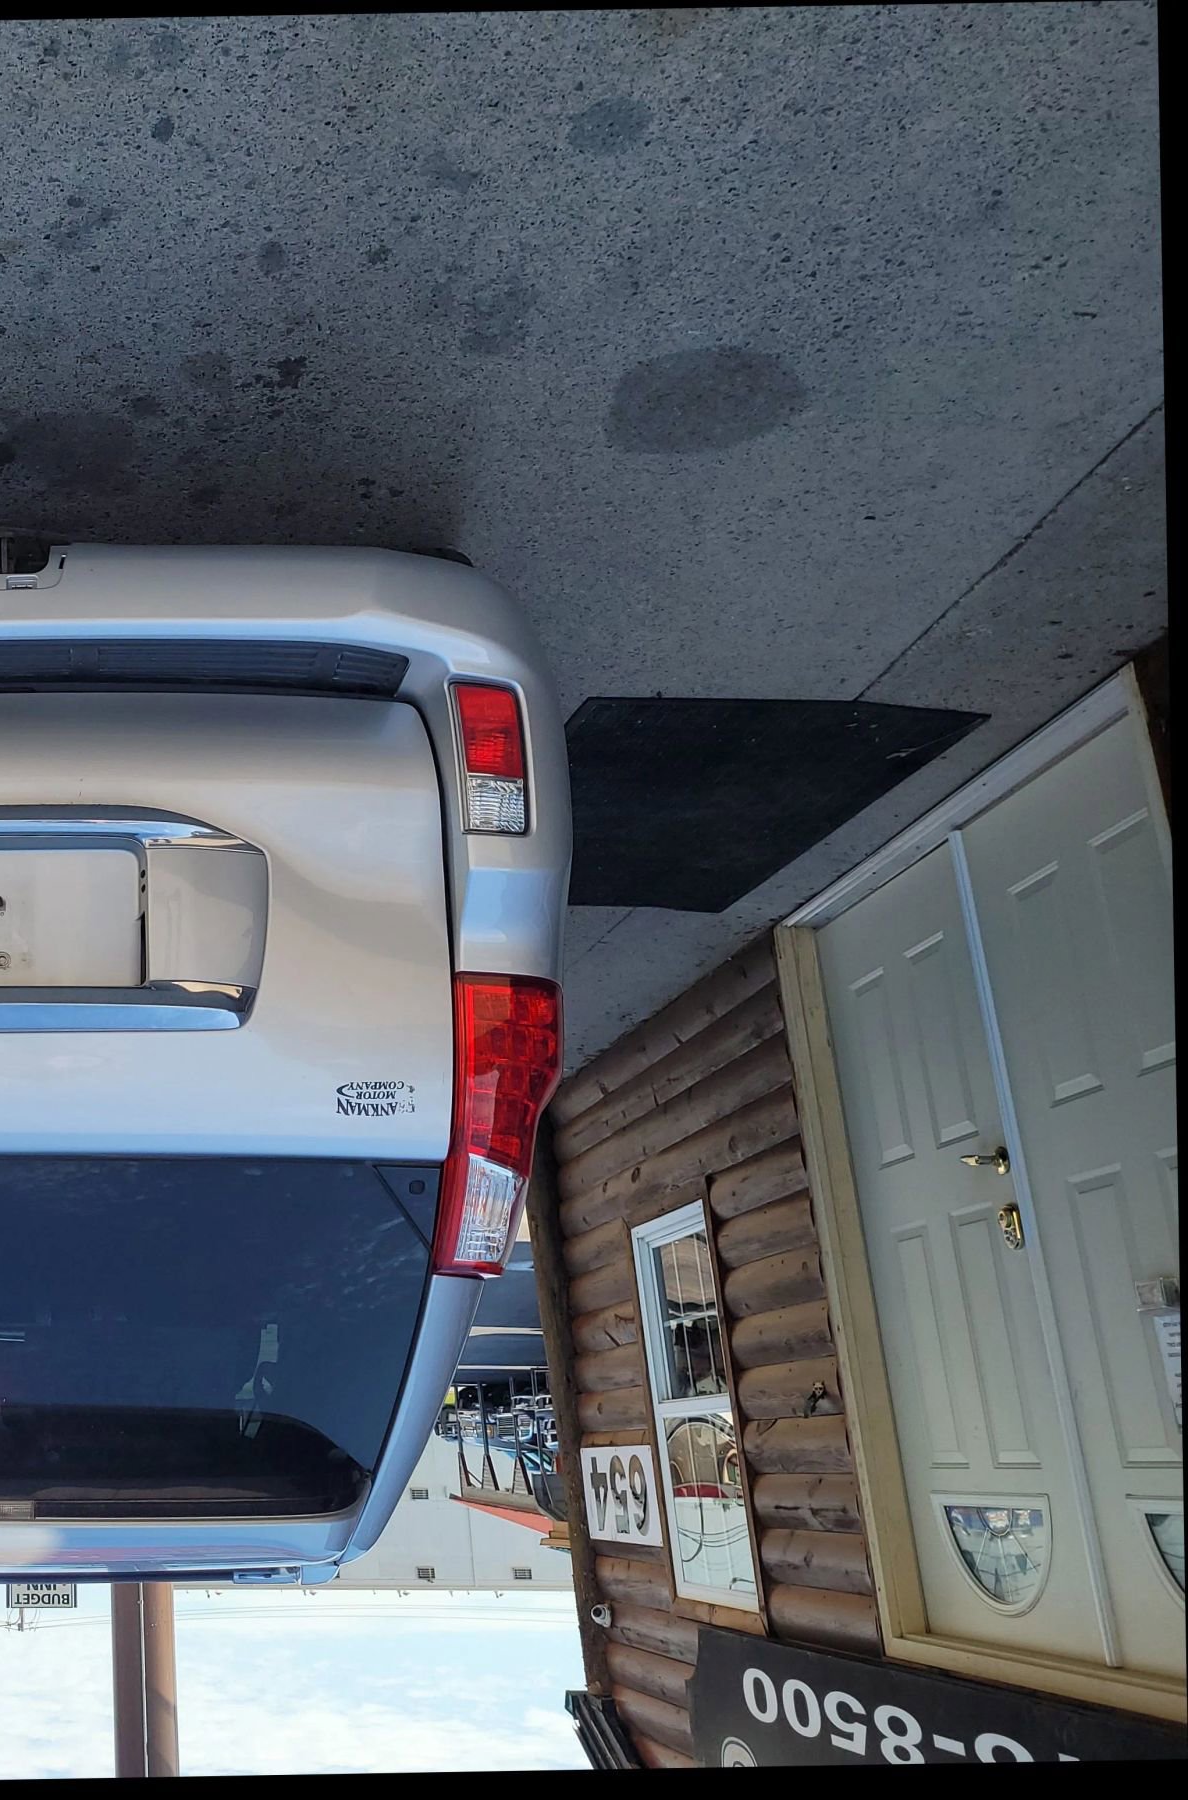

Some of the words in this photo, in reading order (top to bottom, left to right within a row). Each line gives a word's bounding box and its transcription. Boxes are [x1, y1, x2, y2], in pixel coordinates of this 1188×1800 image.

[348, 1081, 404, 1090] COMPANY
[356, 1090, 396, 1100] MOTOR
[590, 1454, 650, 1536] 654
[14, 1593, 70, 1605] BUDGET
